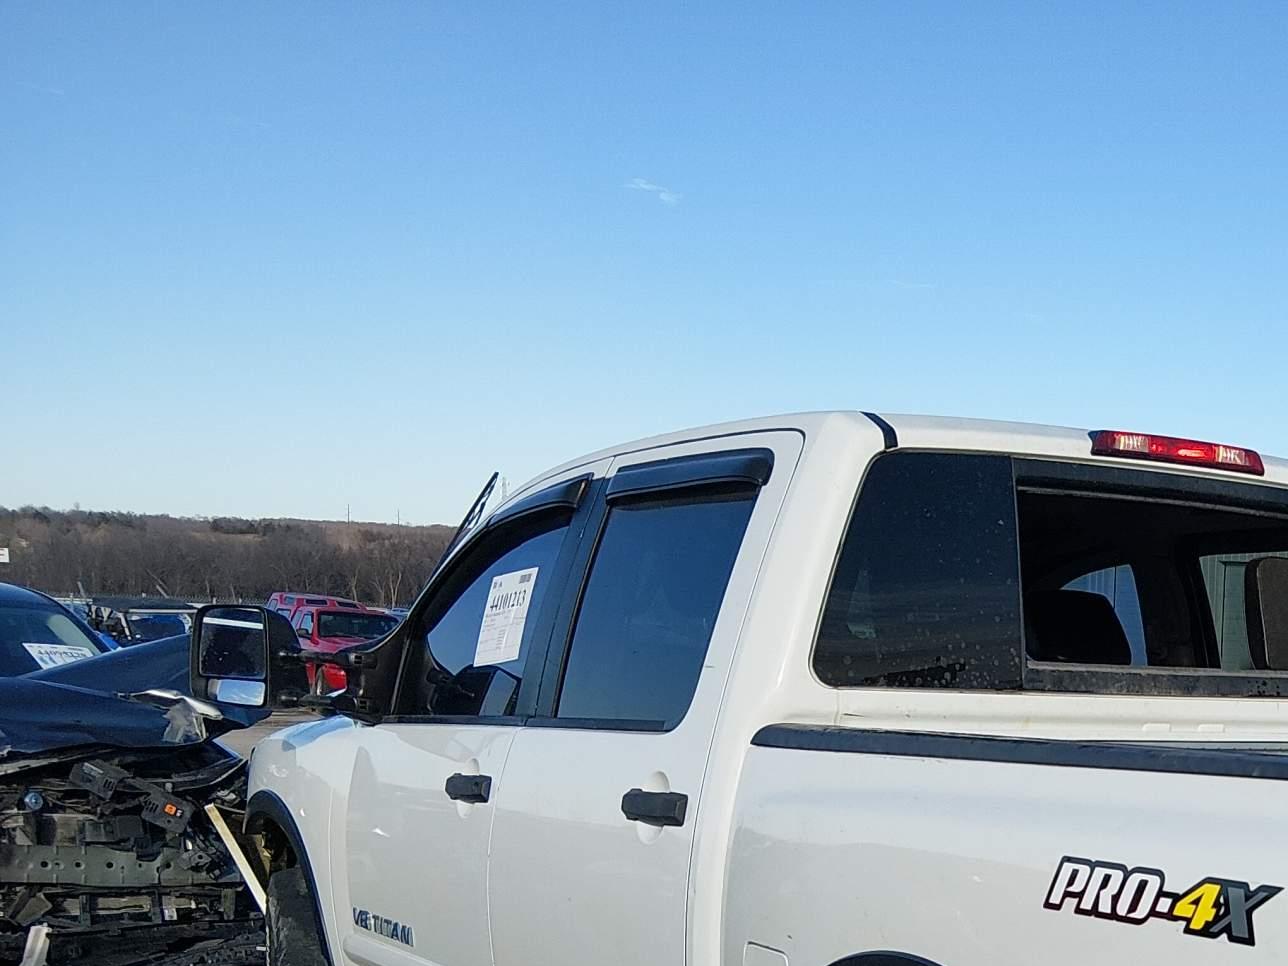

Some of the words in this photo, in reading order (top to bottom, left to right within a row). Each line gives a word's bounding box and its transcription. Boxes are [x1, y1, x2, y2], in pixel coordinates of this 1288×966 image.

[490, 589, 527, 613] 44101213
[1043, 855, 1285, 947] PRO-4X
[372, 914, 414, 947] TITAN
